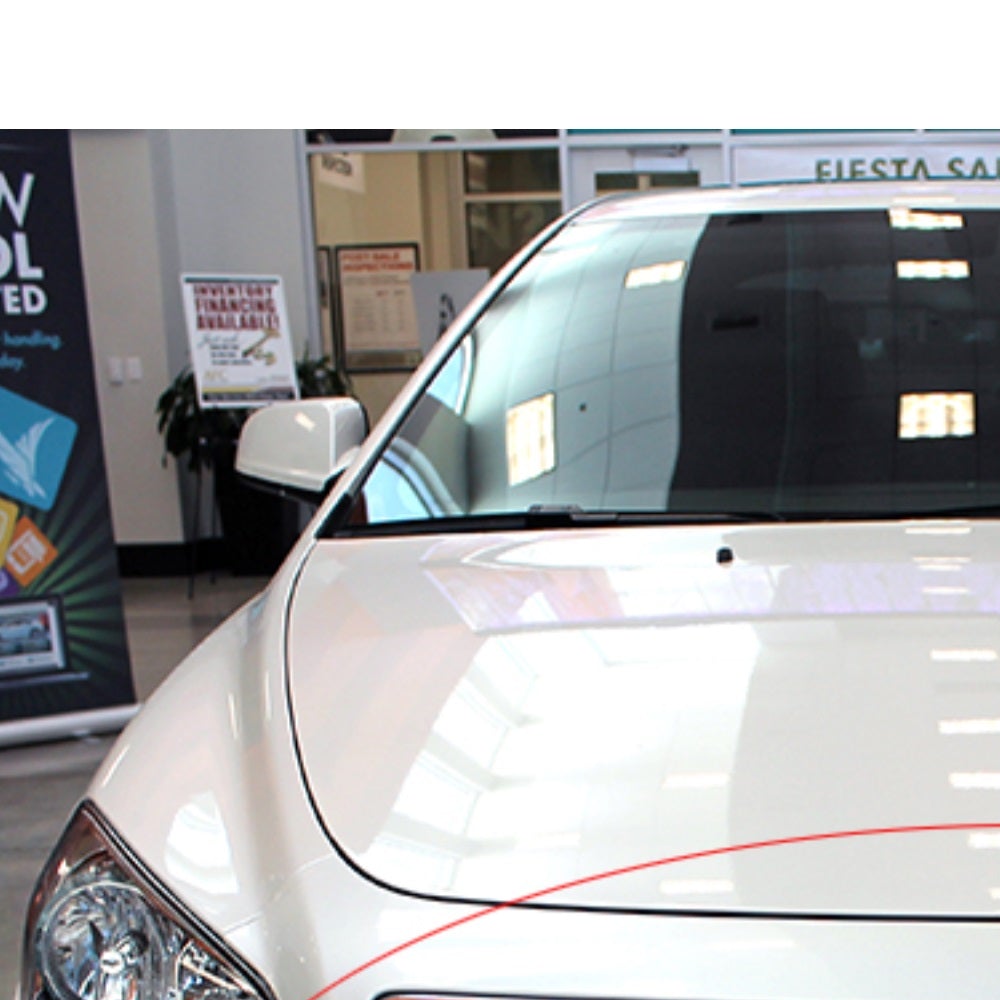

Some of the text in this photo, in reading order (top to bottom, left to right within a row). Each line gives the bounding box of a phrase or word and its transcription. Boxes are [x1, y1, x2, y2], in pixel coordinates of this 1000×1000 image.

[815, 158, 930, 180] FIESTA
[194, 284, 273, 298] INVENTORY
[195, 298, 277, 313] FINANCING
